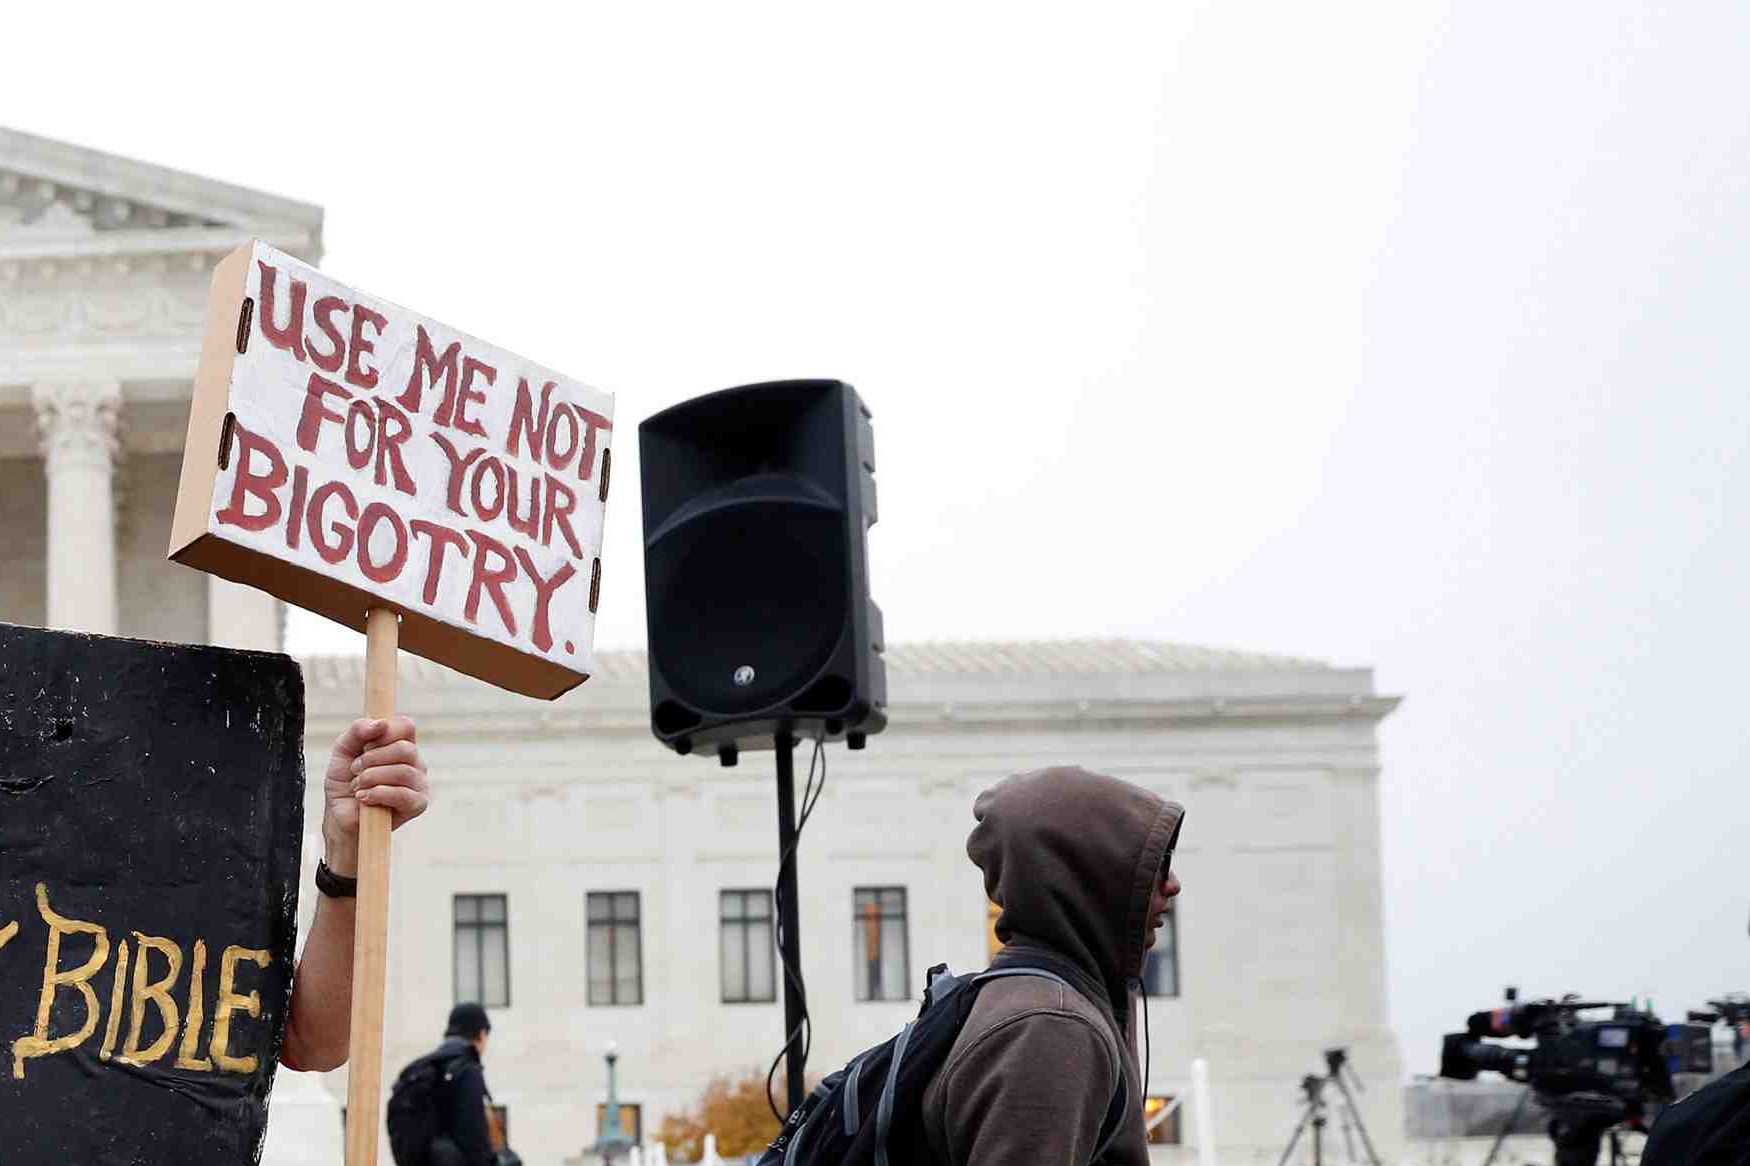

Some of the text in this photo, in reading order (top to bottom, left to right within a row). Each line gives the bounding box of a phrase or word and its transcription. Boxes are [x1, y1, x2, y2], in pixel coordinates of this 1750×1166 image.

[257, 260, 613, 480] USE ME NOT
[296, 373, 583, 560] FOR YOUR
[216, 413, 576, 655] BIGOTRY.
[13, 882, 272, 1079] BIBLE
